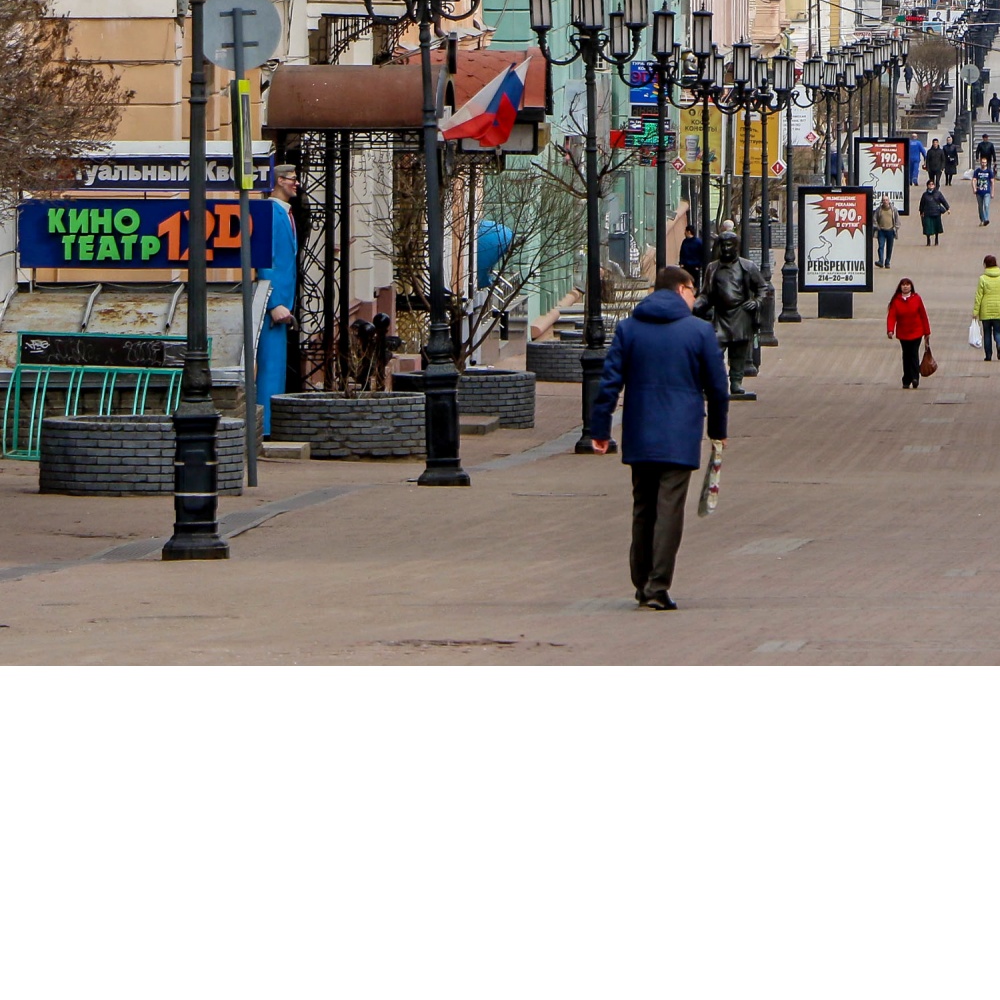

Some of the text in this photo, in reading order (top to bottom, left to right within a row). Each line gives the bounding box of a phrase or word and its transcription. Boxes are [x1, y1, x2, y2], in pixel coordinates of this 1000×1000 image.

[881, 152, 898, 163] 190
[47, 207, 141, 235] КИНО
[834, 208, 857, 222] 190
[61, 234, 161, 262] ТЕАТР
[807, 260, 865, 272] PERSPEKTIVA
[817, 274, 854, 282] 214-20-80
